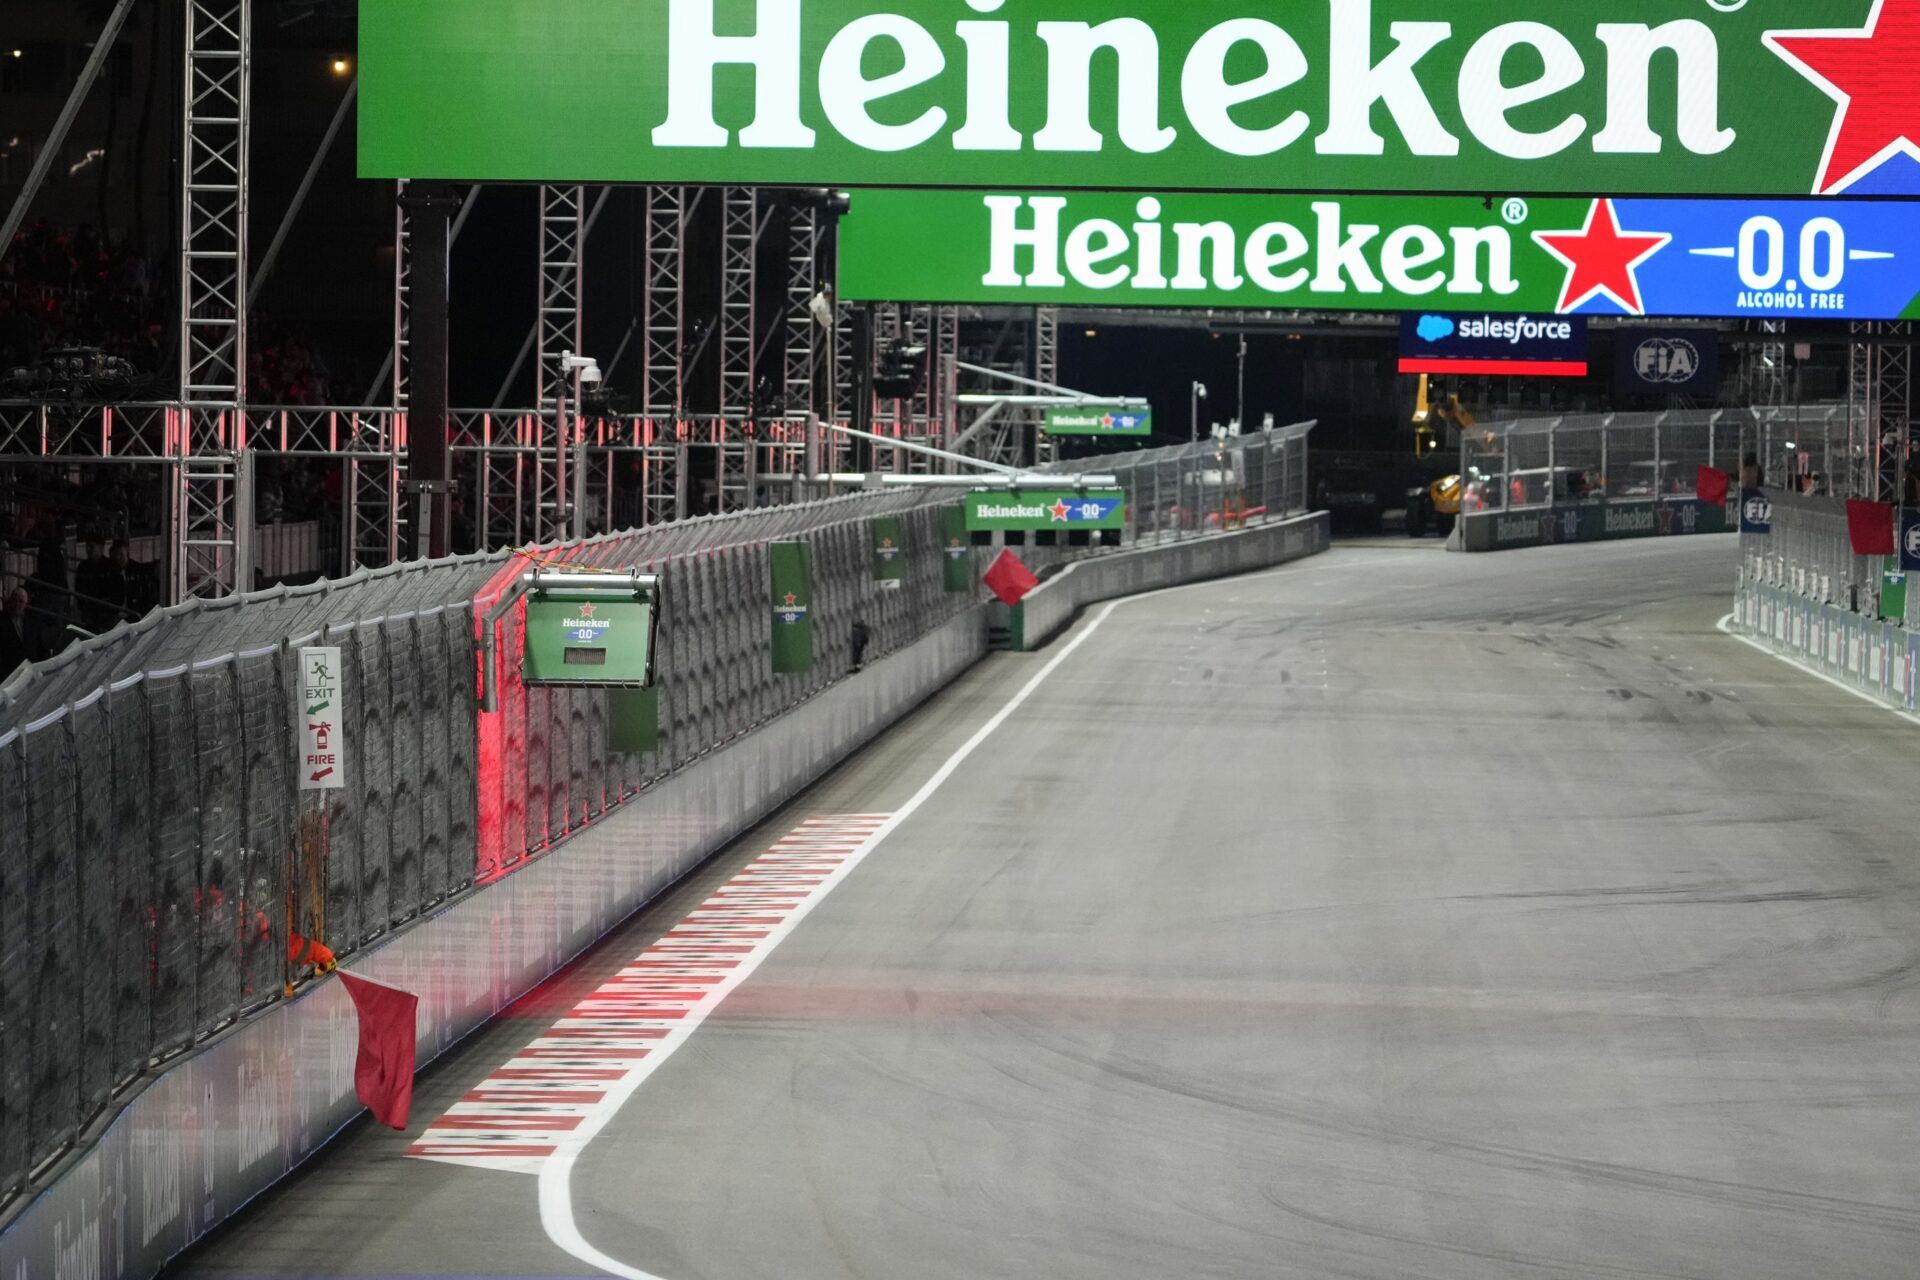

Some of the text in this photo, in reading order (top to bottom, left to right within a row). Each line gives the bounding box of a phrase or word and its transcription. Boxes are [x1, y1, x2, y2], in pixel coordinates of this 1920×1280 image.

[1736, 291, 1844, 309] ALCOHOL FREE
[1459, 315, 1571, 344] salesforce
[306, 688, 335, 699] EXIT
[307, 754, 335, 765] FIRE
